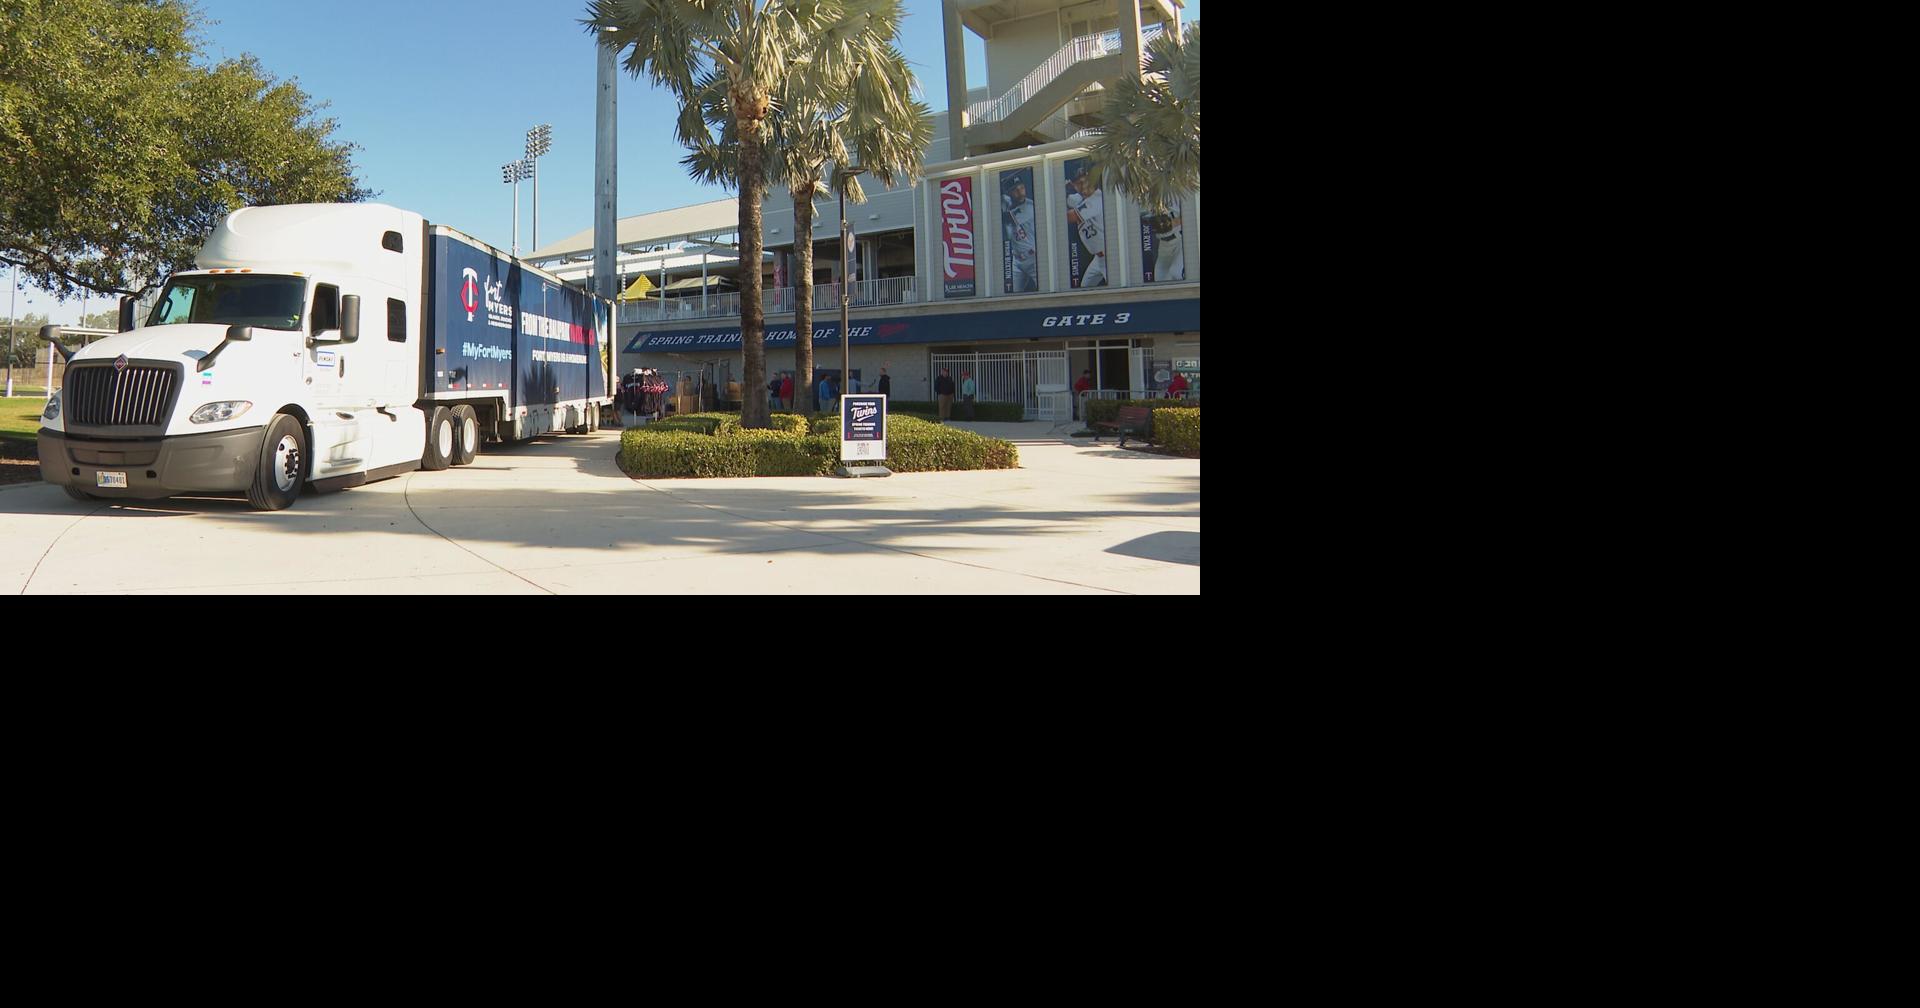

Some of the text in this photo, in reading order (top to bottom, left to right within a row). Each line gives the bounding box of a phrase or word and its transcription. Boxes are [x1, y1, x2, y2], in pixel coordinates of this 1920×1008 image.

[941, 181, 974, 278] Twins
[1082, 224, 1097, 239] 23
[488, 300, 513, 317] MYERS
[1042, 312, 1131, 327] GATE 3
[648, 335, 695, 346] SPRING
[764, 330, 797, 340] HOM
[813, 328, 835, 339] OF
[838, 326, 873, 338] HE
[462, 341, 513, 362] #MyFortMyers
[850, 406, 878, 422] Twins
